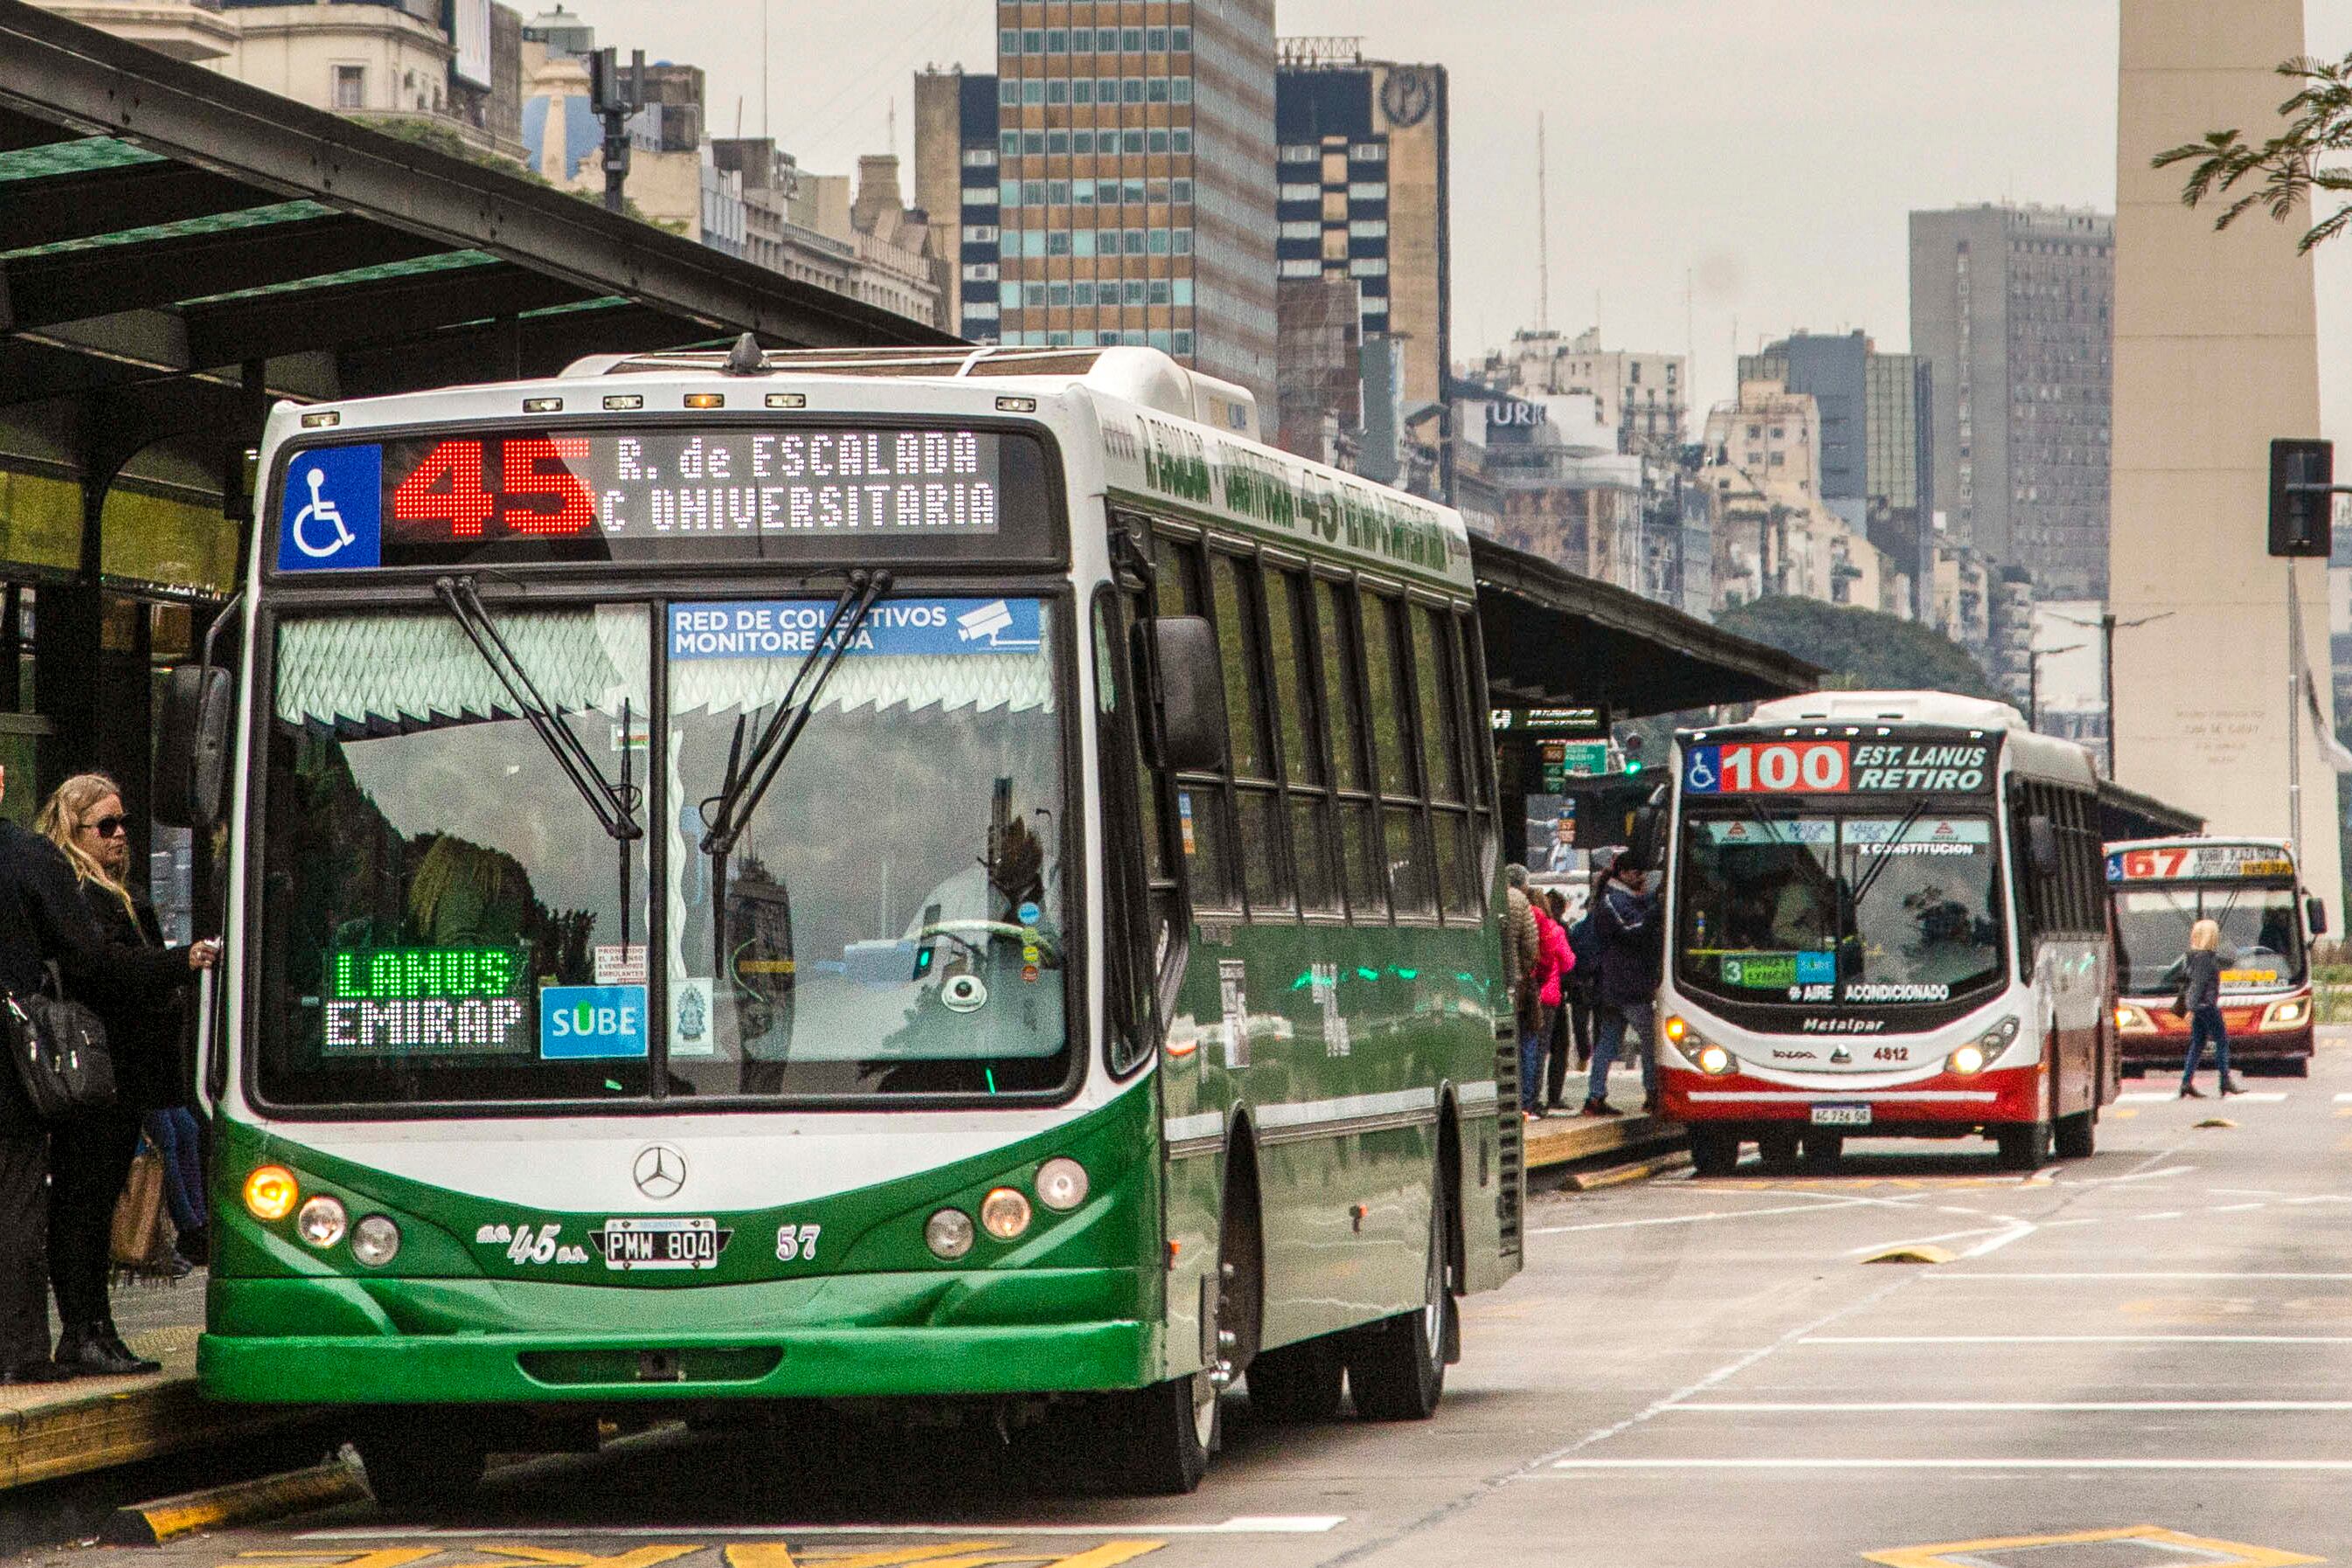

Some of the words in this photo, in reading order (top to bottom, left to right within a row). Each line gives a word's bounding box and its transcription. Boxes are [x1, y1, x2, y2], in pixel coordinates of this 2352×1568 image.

[618, 438, 657, 480] R.
[680, 437, 731, 478] de
[753, 432, 977, 477] ESCALADA
[394, 440, 596, 535] 45
[602, 489, 626, 531] C
[651, 482, 994, 531] UNIVERSITARIA
[675, 611, 727, 631] RED
[735, 610, 775, 630] DE
[675, 628, 874, 653] MONITOREADA
[1723, 746, 1843, 789] 100
[1853, 746, 1900, 767] EST.
[1906, 746, 1988, 767] LANUS
[1856, 769, 1985, 791] RETIRO
[2125, 848, 2189, 878] 67
[336, 951, 510, 997] LANUS
[1726, 961, 1742, 982] 3
[1803, 985, 1834, 1002] AIRE
[1845, 984, 1950, 1002] ACONDICIONADO
[326, 999, 523, 1046] EMIRAP
[552, 1001, 636, 1037] SUBE
[1803, 1017, 1884, 1033] Metalpar
[1873, 1047, 1909, 1061] 4812
[507, 1223, 562, 1265] 45
[610, 1232, 659, 1259] PMW
[669, 1231, 712, 1259] 804
[775, 1225, 821, 1261] 57
